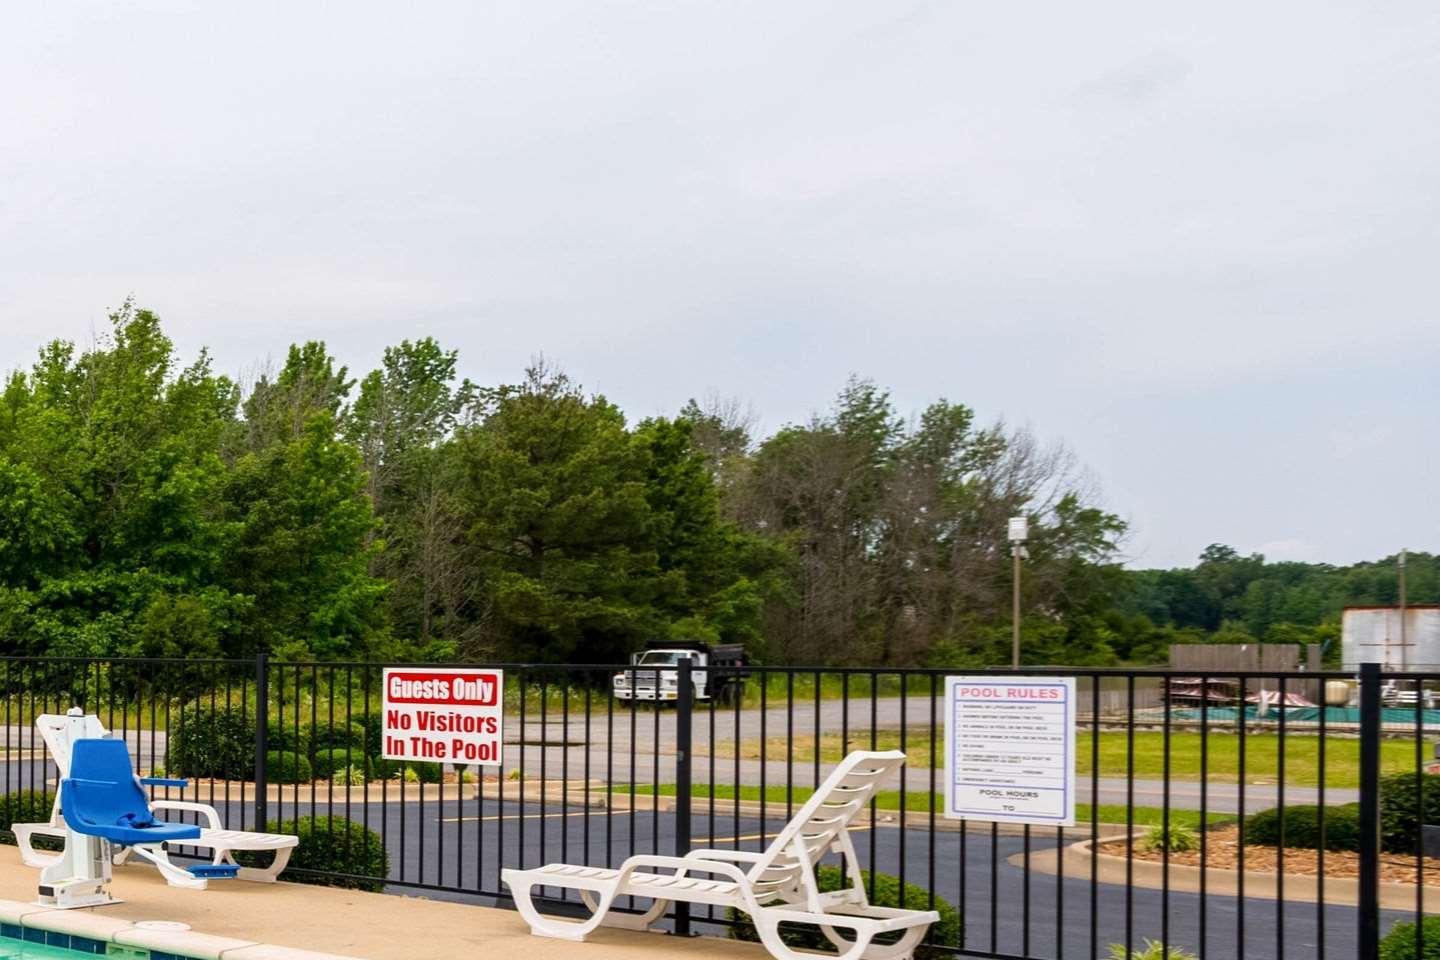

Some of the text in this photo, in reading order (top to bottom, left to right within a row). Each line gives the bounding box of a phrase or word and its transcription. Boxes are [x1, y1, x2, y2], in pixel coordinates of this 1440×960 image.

[390, 676, 493, 703] Guests Only
[960, 687, 1059, 699] POOL RULES
[387, 709, 497, 734] No Visitors
[386, 735, 497, 761] In The Pool
